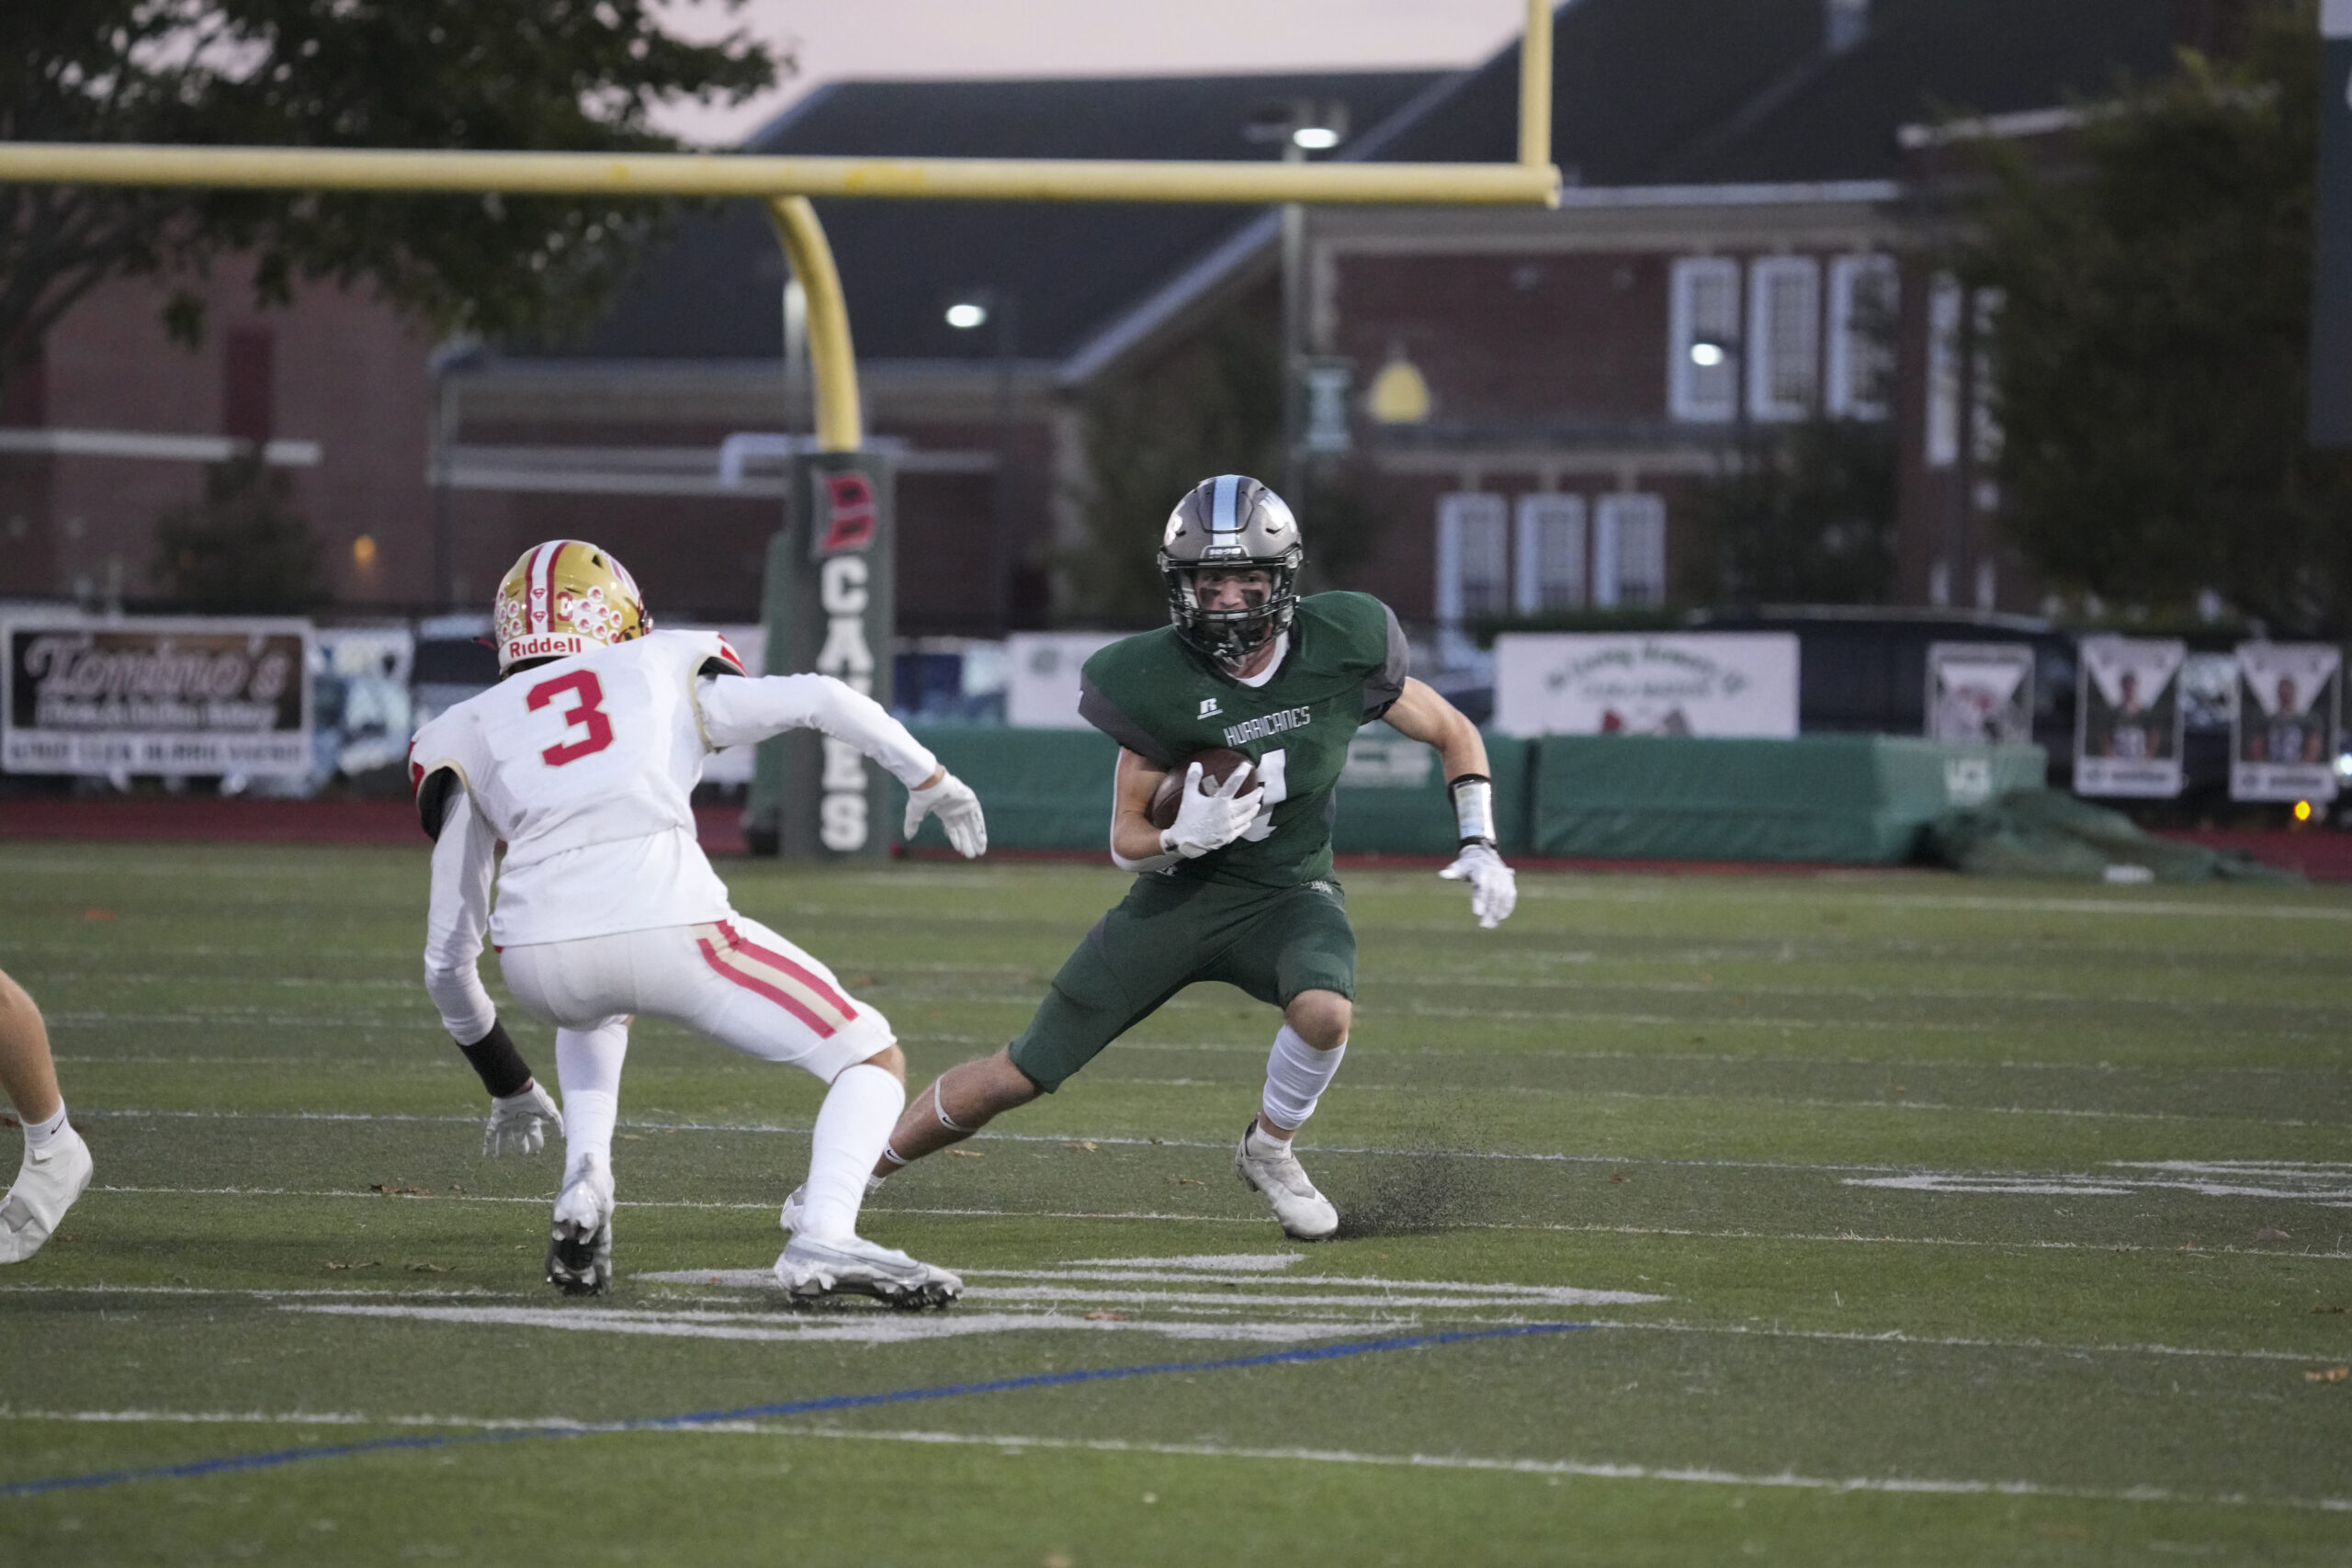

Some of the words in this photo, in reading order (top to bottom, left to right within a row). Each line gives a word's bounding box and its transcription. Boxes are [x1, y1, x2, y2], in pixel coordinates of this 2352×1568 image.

[509, 637, 582, 659] Riddell
[526, 668, 616, 768] 3
[818, 554, 873, 852] CAES
[1223, 705, 1311, 748] HURRICANES
